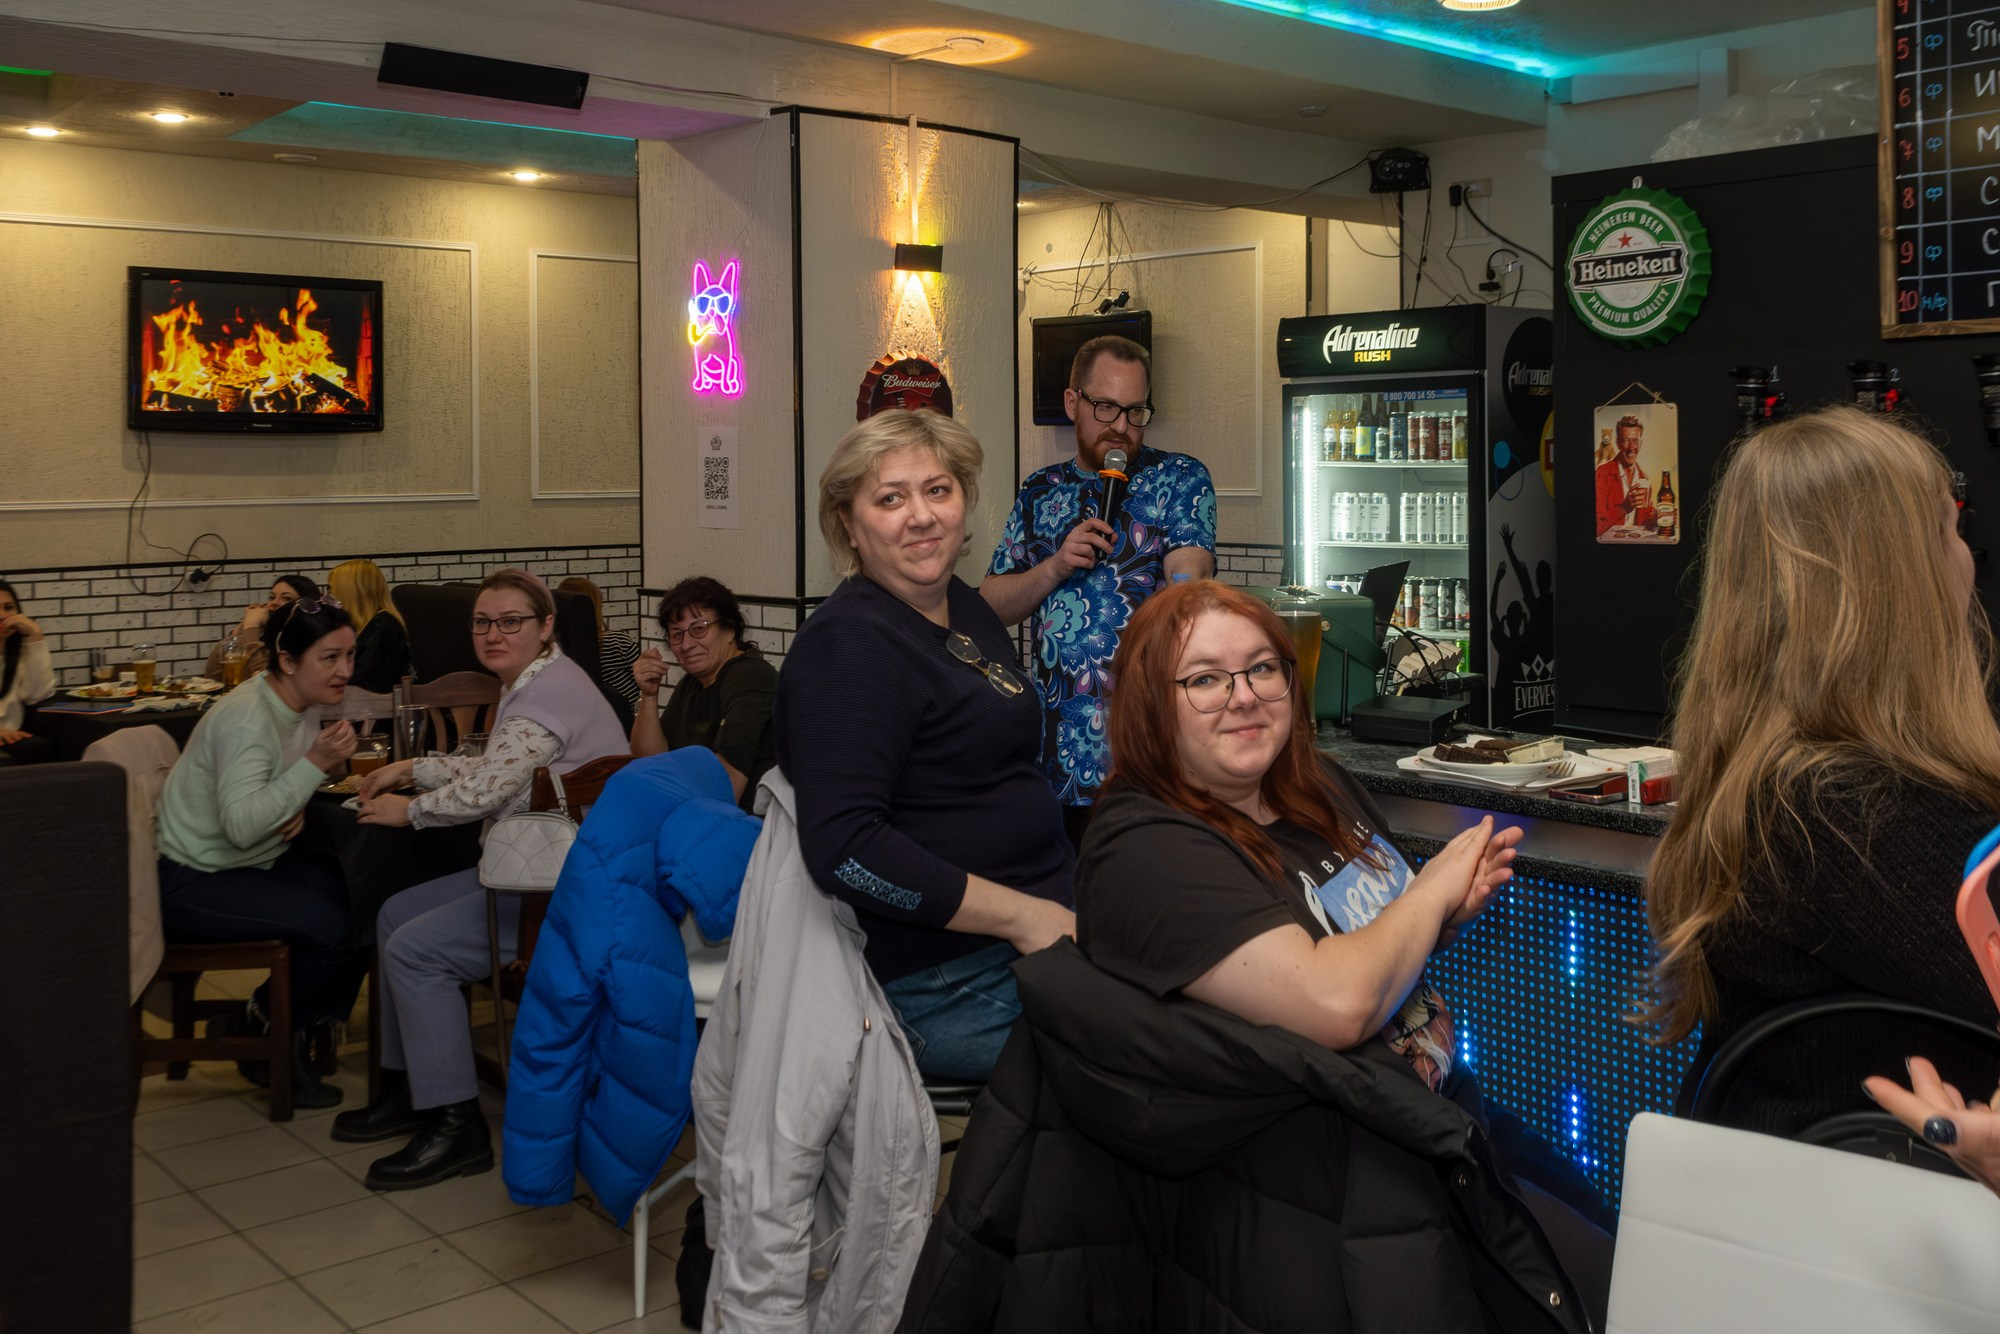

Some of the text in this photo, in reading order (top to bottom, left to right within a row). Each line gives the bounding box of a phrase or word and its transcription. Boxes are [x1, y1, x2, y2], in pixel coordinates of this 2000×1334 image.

[1896, 36, 1910, 61] 5
[1897, 87, 1911, 108] 6
[1973, 68, 2000, 98] И
[1898, 138, 1915, 161] 7
[1902, 186, 1915, 210] 8
[1588, 211, 1665, 244] HEINEKEN BEER
[1899, 240, 1915, 265] 9
[1579, 254, 1677, 282] Heineken
[1587, 288, 1670, 323] PREMIUM QUALITY
[1898, 288, 1919, 313] 10
[1322, 322, 1420, 364] Adrenaline
[1354, 349, 1391, 363] RUSH
[881, 373, 942, 389] Budweiser
[1769, 365, 1780, 383] 1
[1383, 392, 1389, 400] 8
[1403, 391, 1416, 400] 700
[1417, 391, 1425, 399] 14
